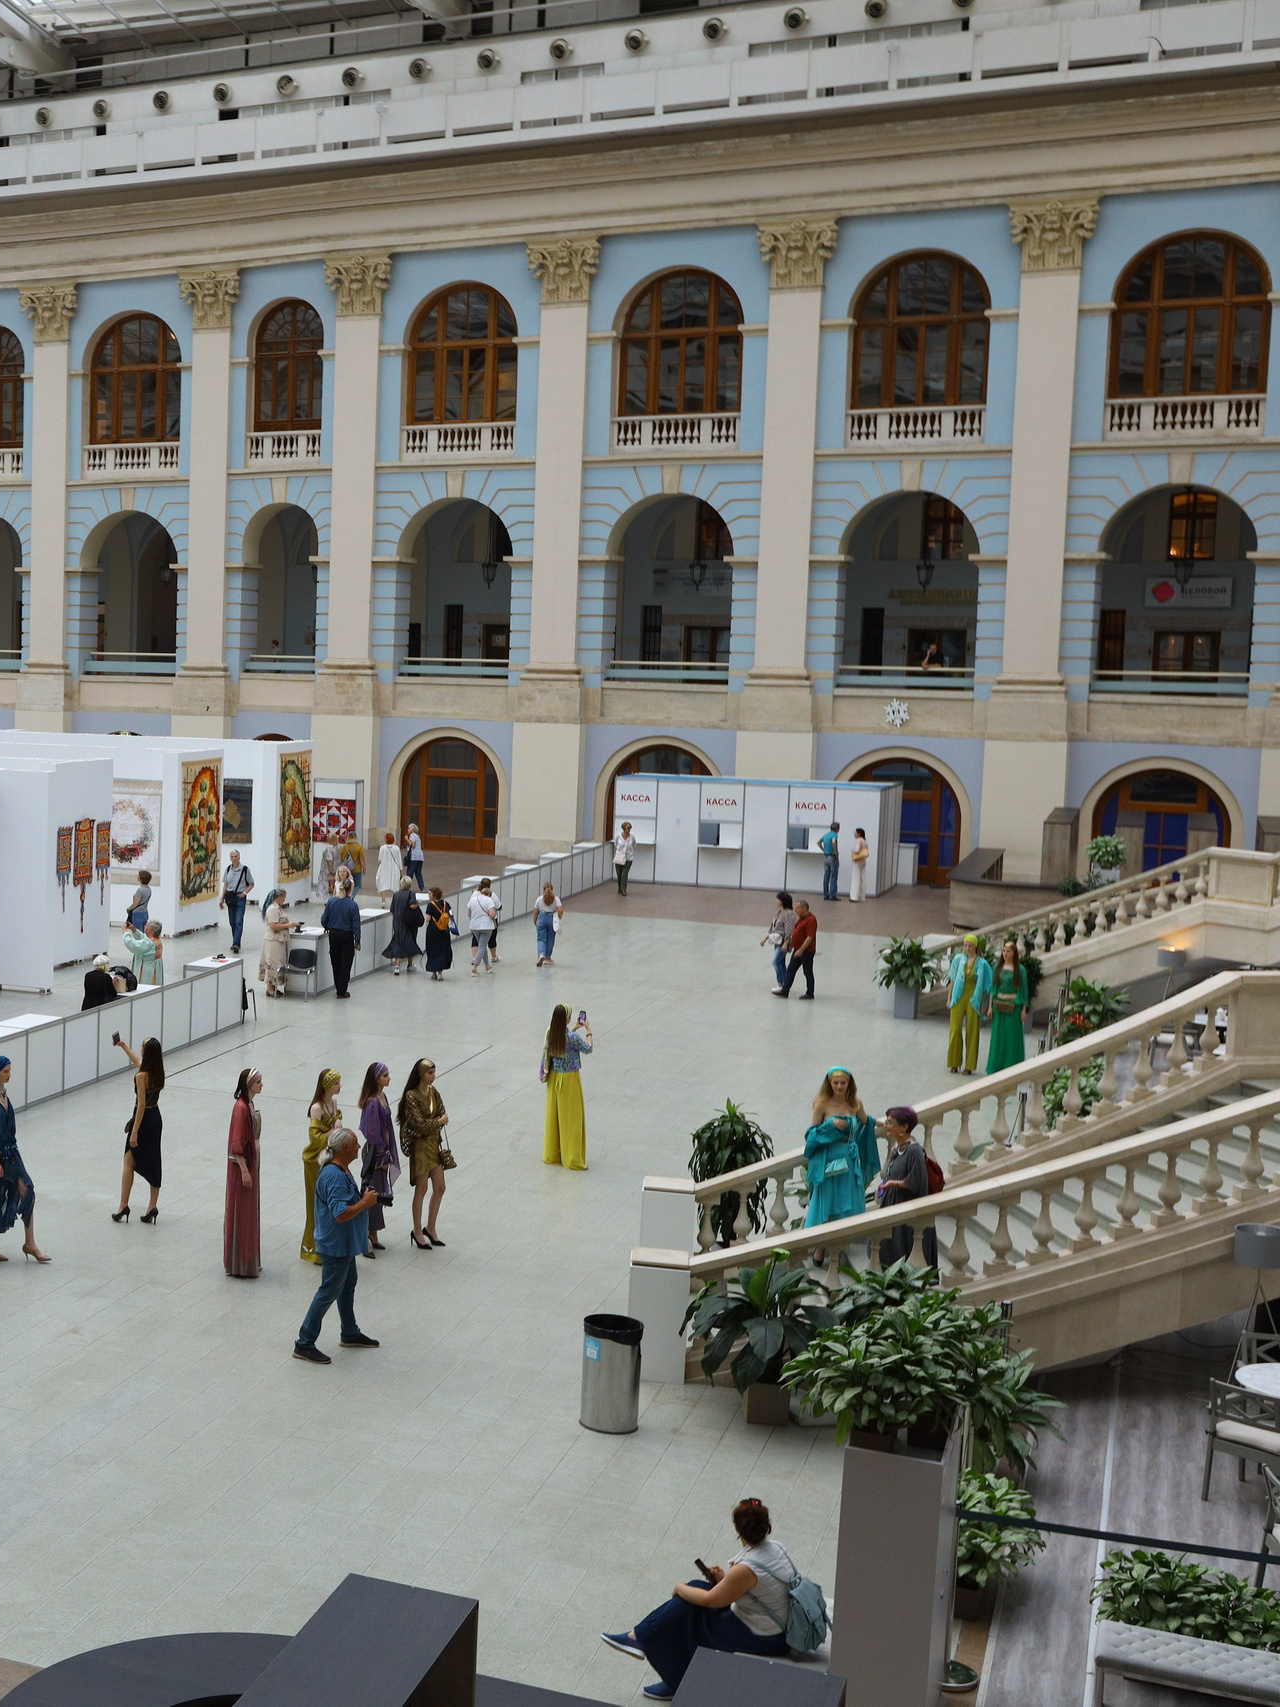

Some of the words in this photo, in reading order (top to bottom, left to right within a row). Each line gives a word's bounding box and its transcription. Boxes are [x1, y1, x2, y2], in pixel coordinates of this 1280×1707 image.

[621, 794, 651, 803] КАССА
[706, 797, 737, 807] КАССА
[795, 801, 827, 811] КАССА
